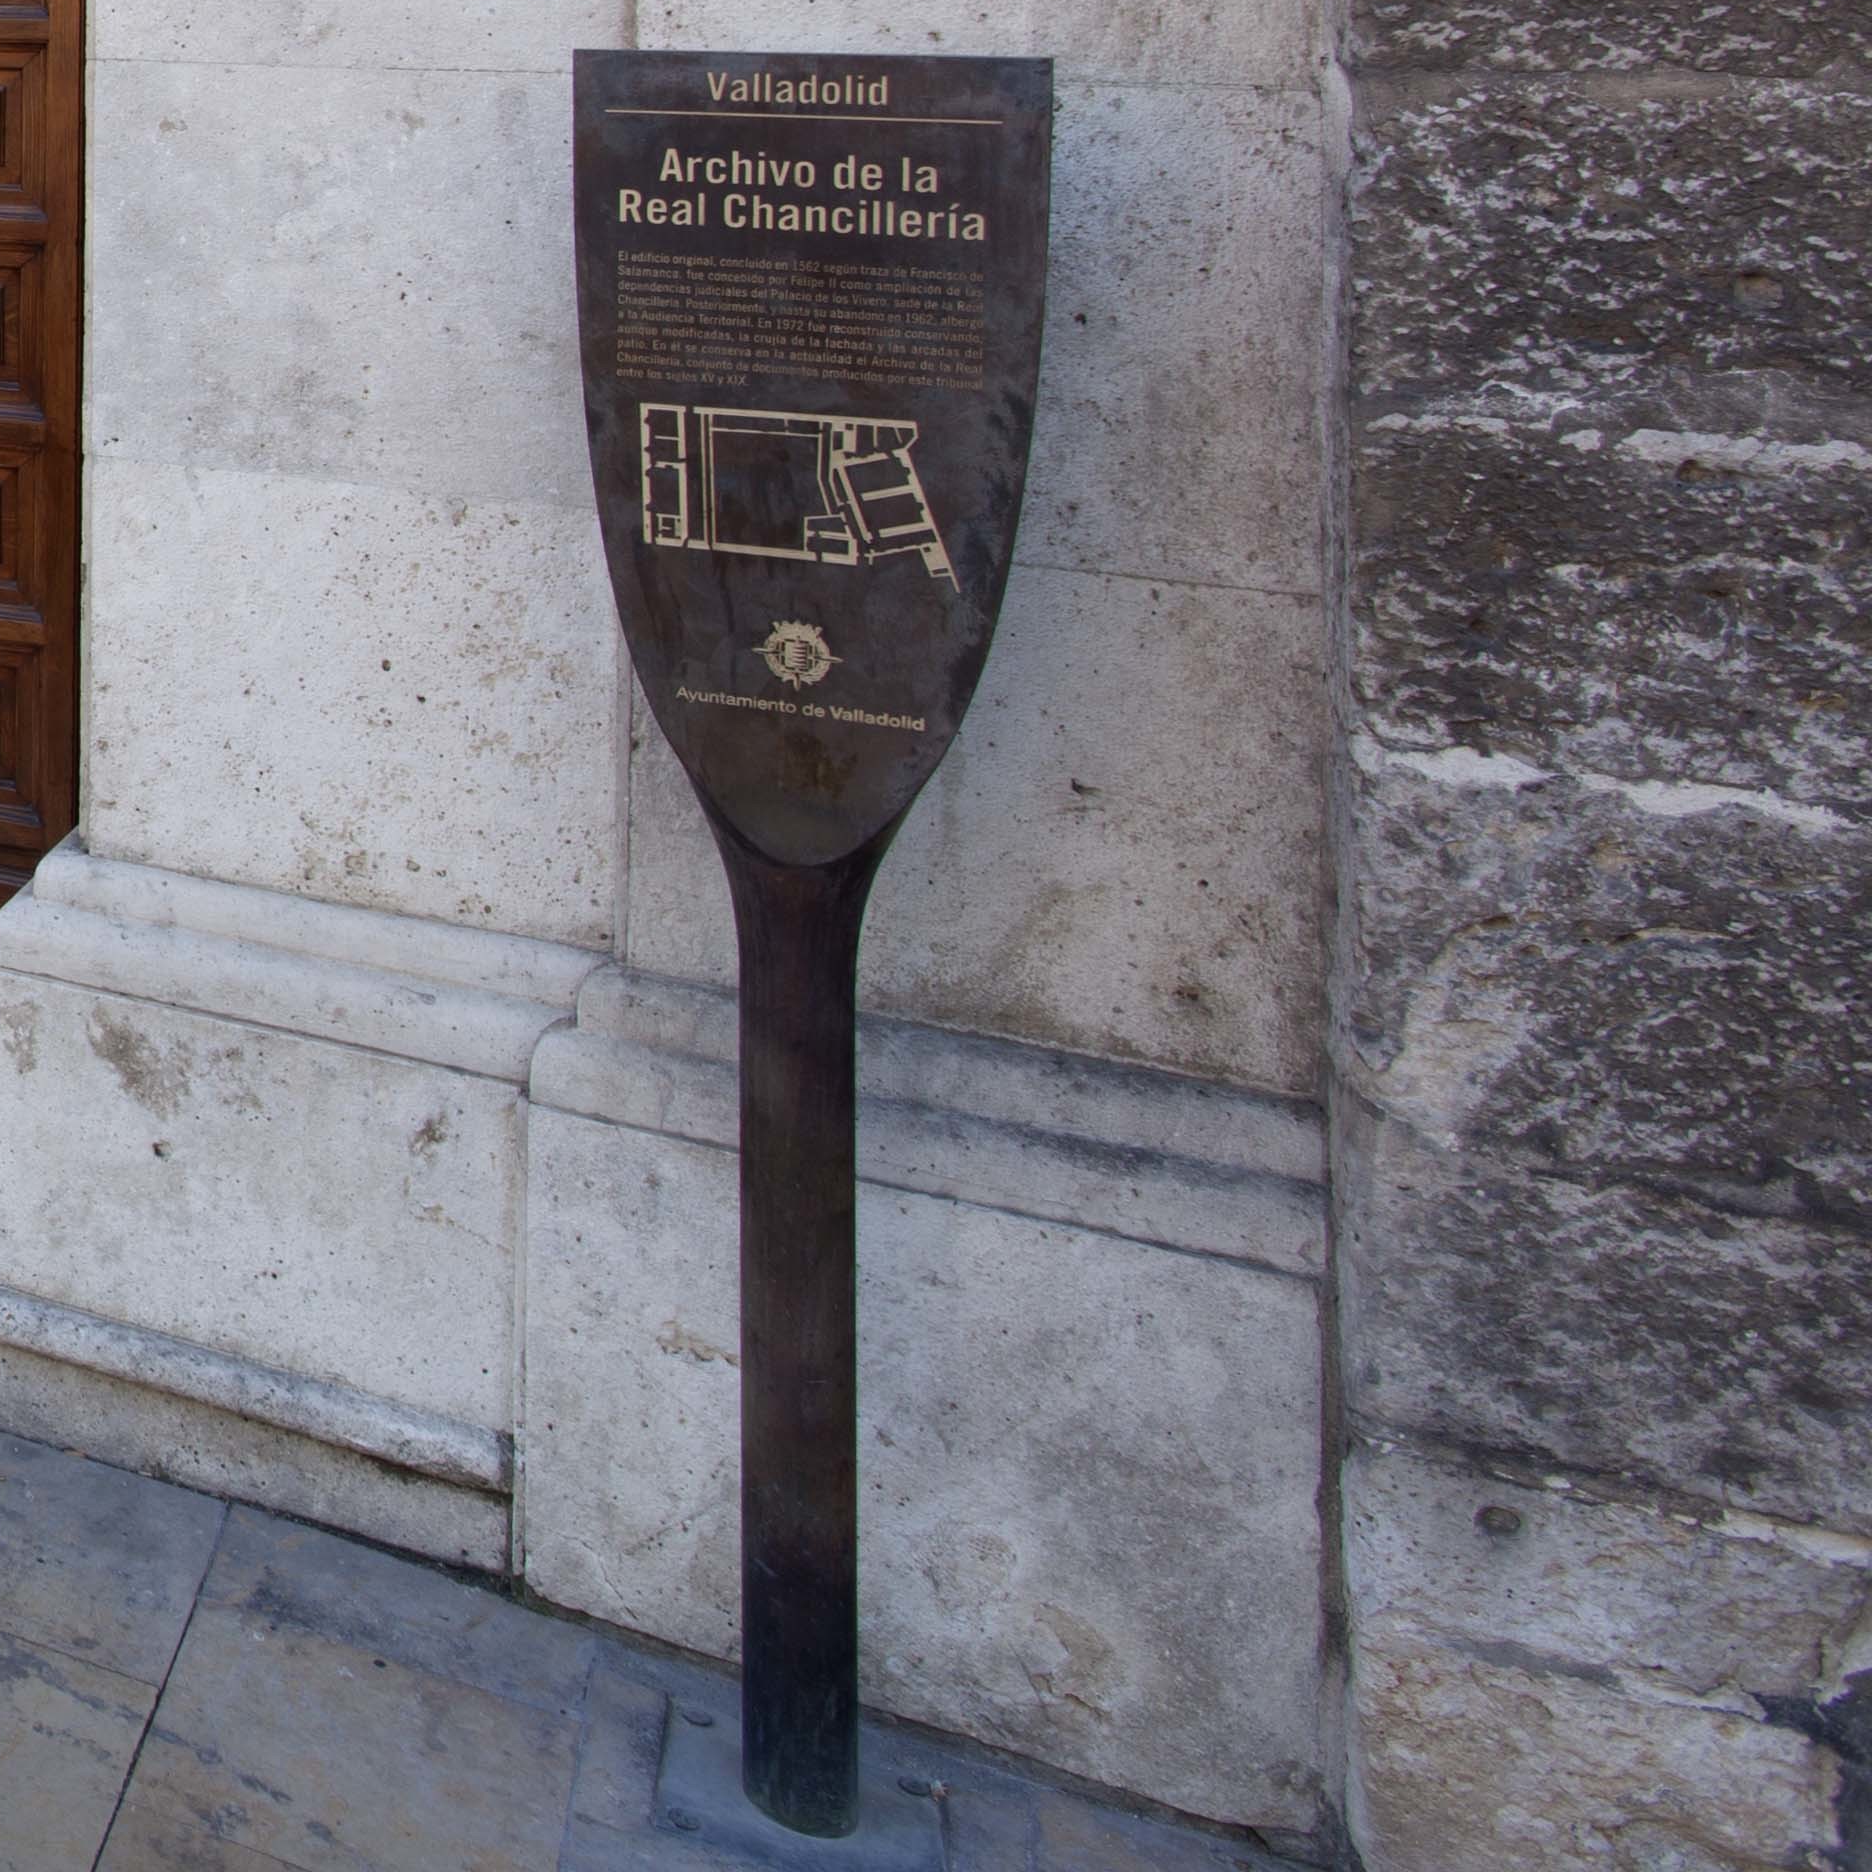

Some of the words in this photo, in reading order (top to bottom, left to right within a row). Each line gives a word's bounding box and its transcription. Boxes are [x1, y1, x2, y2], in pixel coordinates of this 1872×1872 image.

[706, 71, 890, 107] Valladolid
[659, 148, 816, 189] Archivo
[833, 155, 883, 191] de
[901, 156, 939, 194] la
[618, 189, 706, 227] Real
[723, 193, 987, 241] Chancillería
[618, 251, 628, 261] El
[631, 252, 670, 264] edificio
[720, 257, 771, 269] concluido
[792, 260, 820, 273] 1562
[824, 263, 856, 275] según
[861, 265, 888, 276] traza
[911, 268, 969, 280] Francisco
[708, 271, 765, 283] concebido
[791, 275, 824, 288] Felipe
[840, 280, 871, 289] como
[618, 280, 691, 295] dependencias
[695, 285, 745, 297] judiciales
[771, 289, 812, 301] Palacio
[958, 301, 983, 312] Real
[642, 311, 695, 324] Audiencia
[699, 314, 754, 327] Territorial.
[777, 320, 804, 331] 1972
[830, 325, 900, 337] reconstruido
[830, 308, 885, 321] abandono
[618, 326, 658, 335] aunque
[662, 327, 734, 341] modificadas,
[826, 337, 873, 350] fachada
[912, 345, 959, 357] arcadas
[617, 368, 644, 377] entre
[686, 358, 732, 370] conjunto
[823, 368, 883, 383] producidos
[909, 375, 934, 386] este
[937, 378, 983, 389] tribunal
[702, 345, 751, 357] conserva
[790, 350, 852, 365] actualidad
[872, 356, 916, 369] Archivo
[956, 363, 983, 374] Real
[675, 685, 796, 716] Ayuntamiento
[802, 703, 825, 719] de
[829, 705, 926, 732] Valladolid
